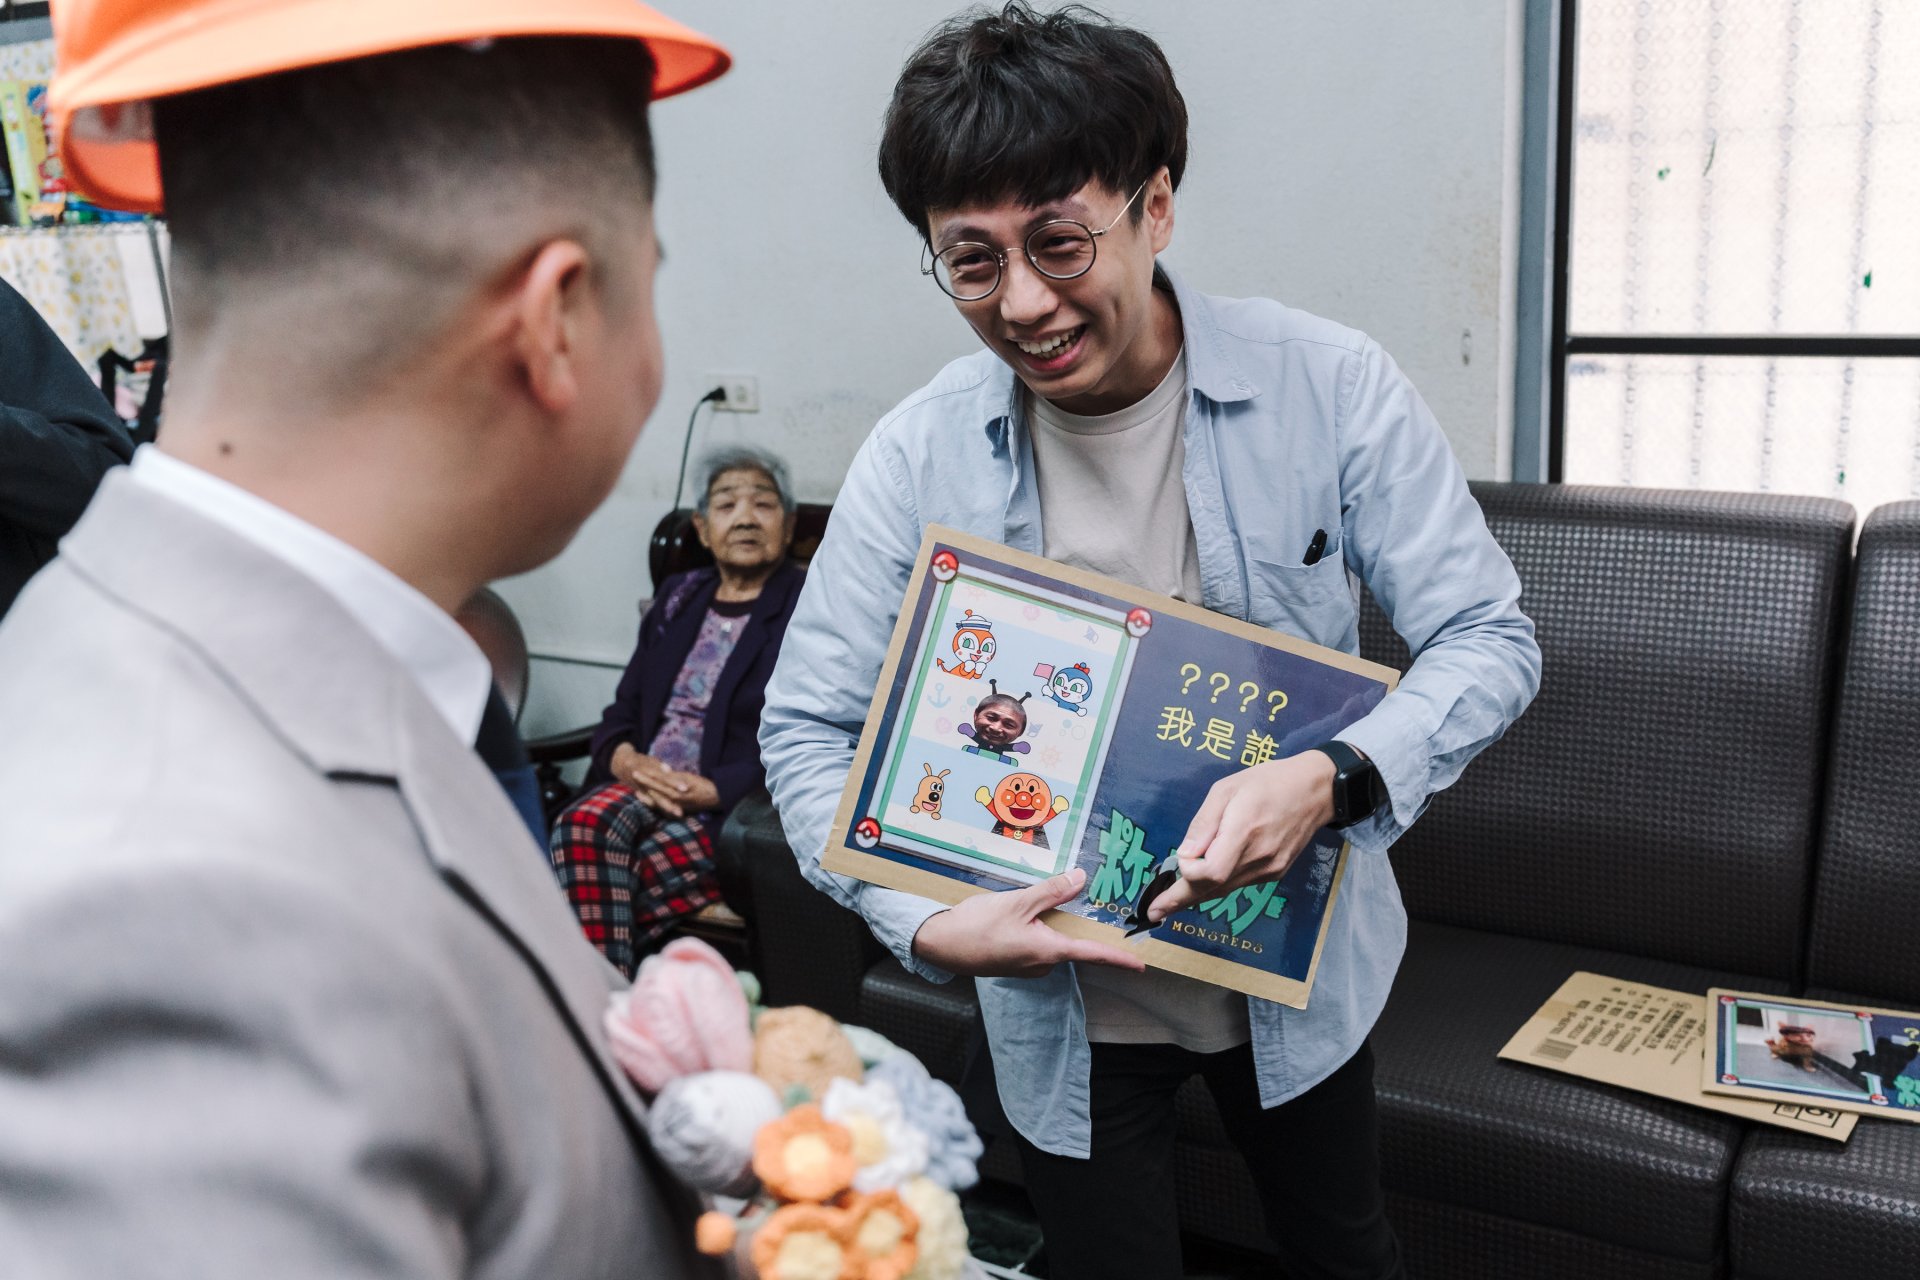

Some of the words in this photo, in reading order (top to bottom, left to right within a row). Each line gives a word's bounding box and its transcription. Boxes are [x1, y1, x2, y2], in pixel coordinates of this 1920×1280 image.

[1156, 706, 1280, 767] 我是誰
[1172, 920, 1264, 954] MONSTERS
